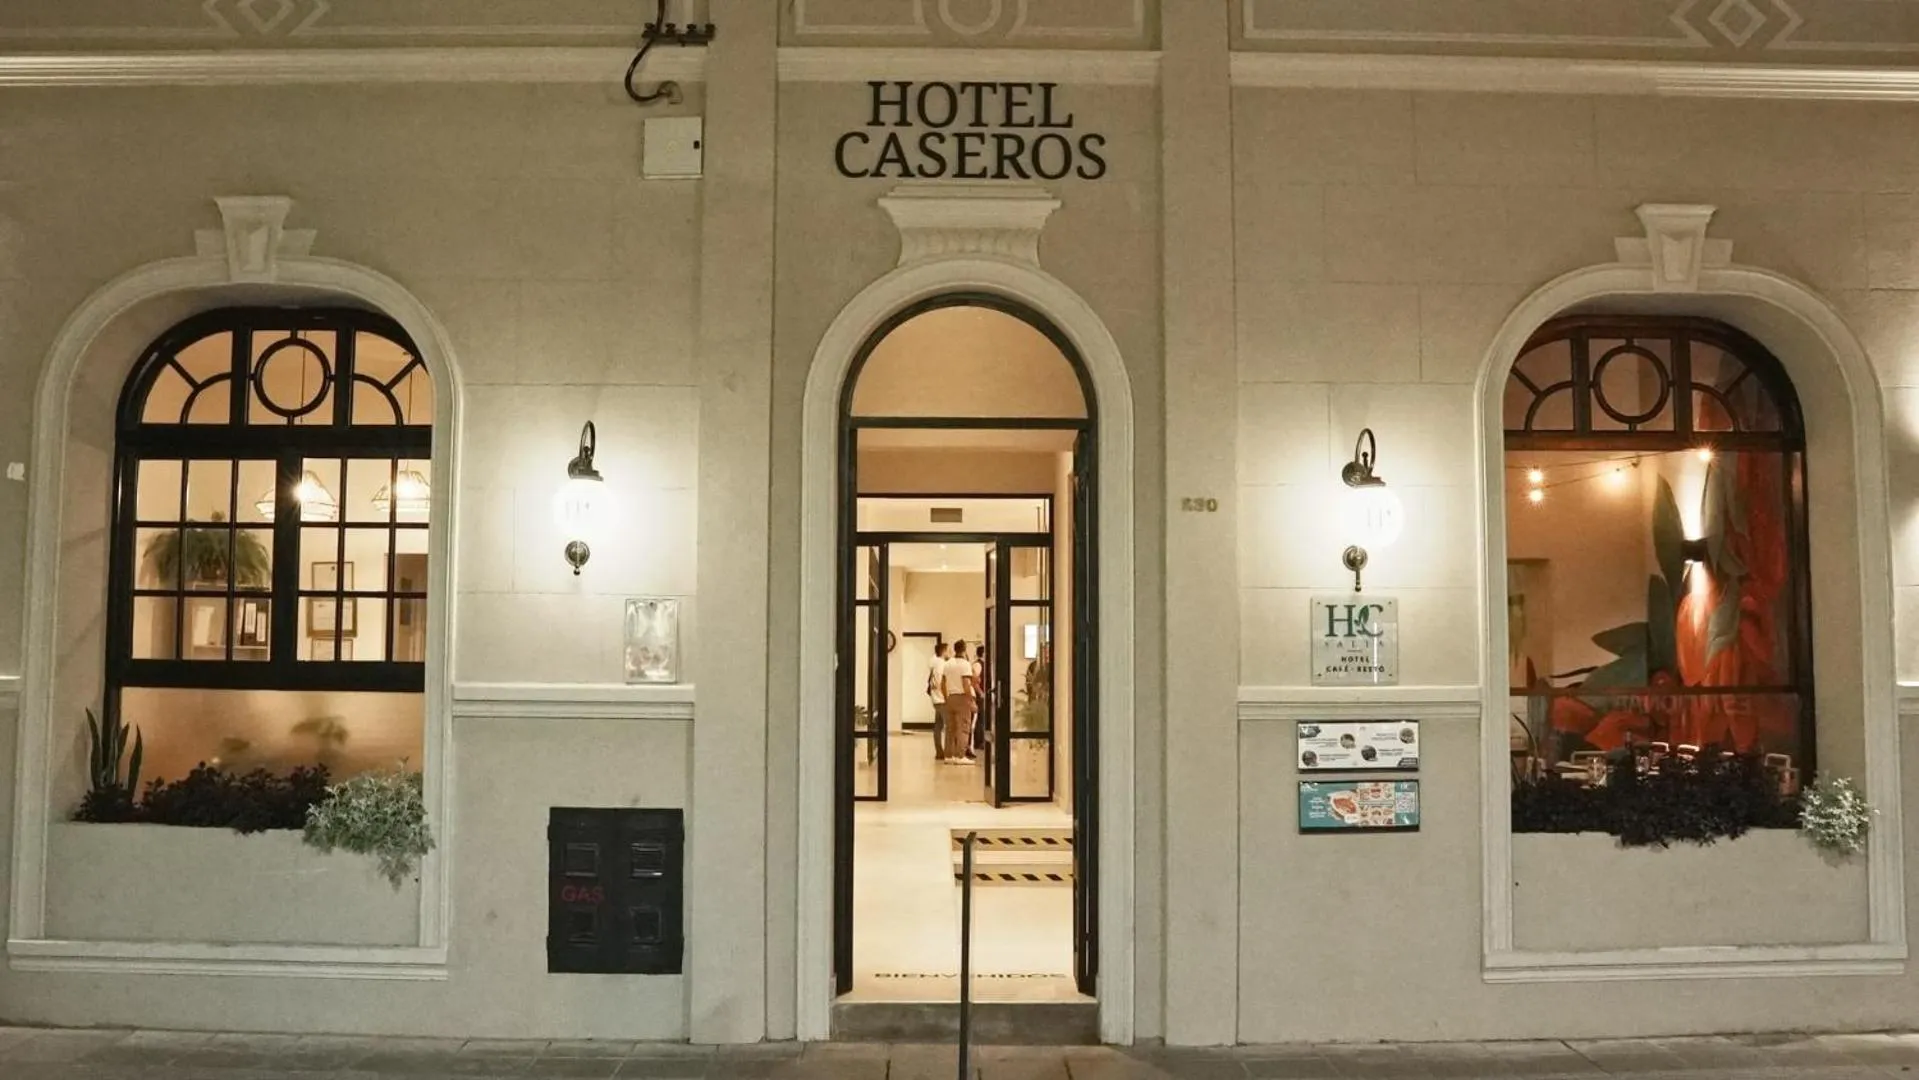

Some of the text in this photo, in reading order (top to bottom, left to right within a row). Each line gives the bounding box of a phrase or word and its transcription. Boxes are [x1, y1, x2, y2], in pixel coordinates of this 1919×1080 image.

[866, 81, 1073, 128] HOTEL
[835, 131, 1106, 180] CASEROS
[561, 886, 604, 902] GAS
